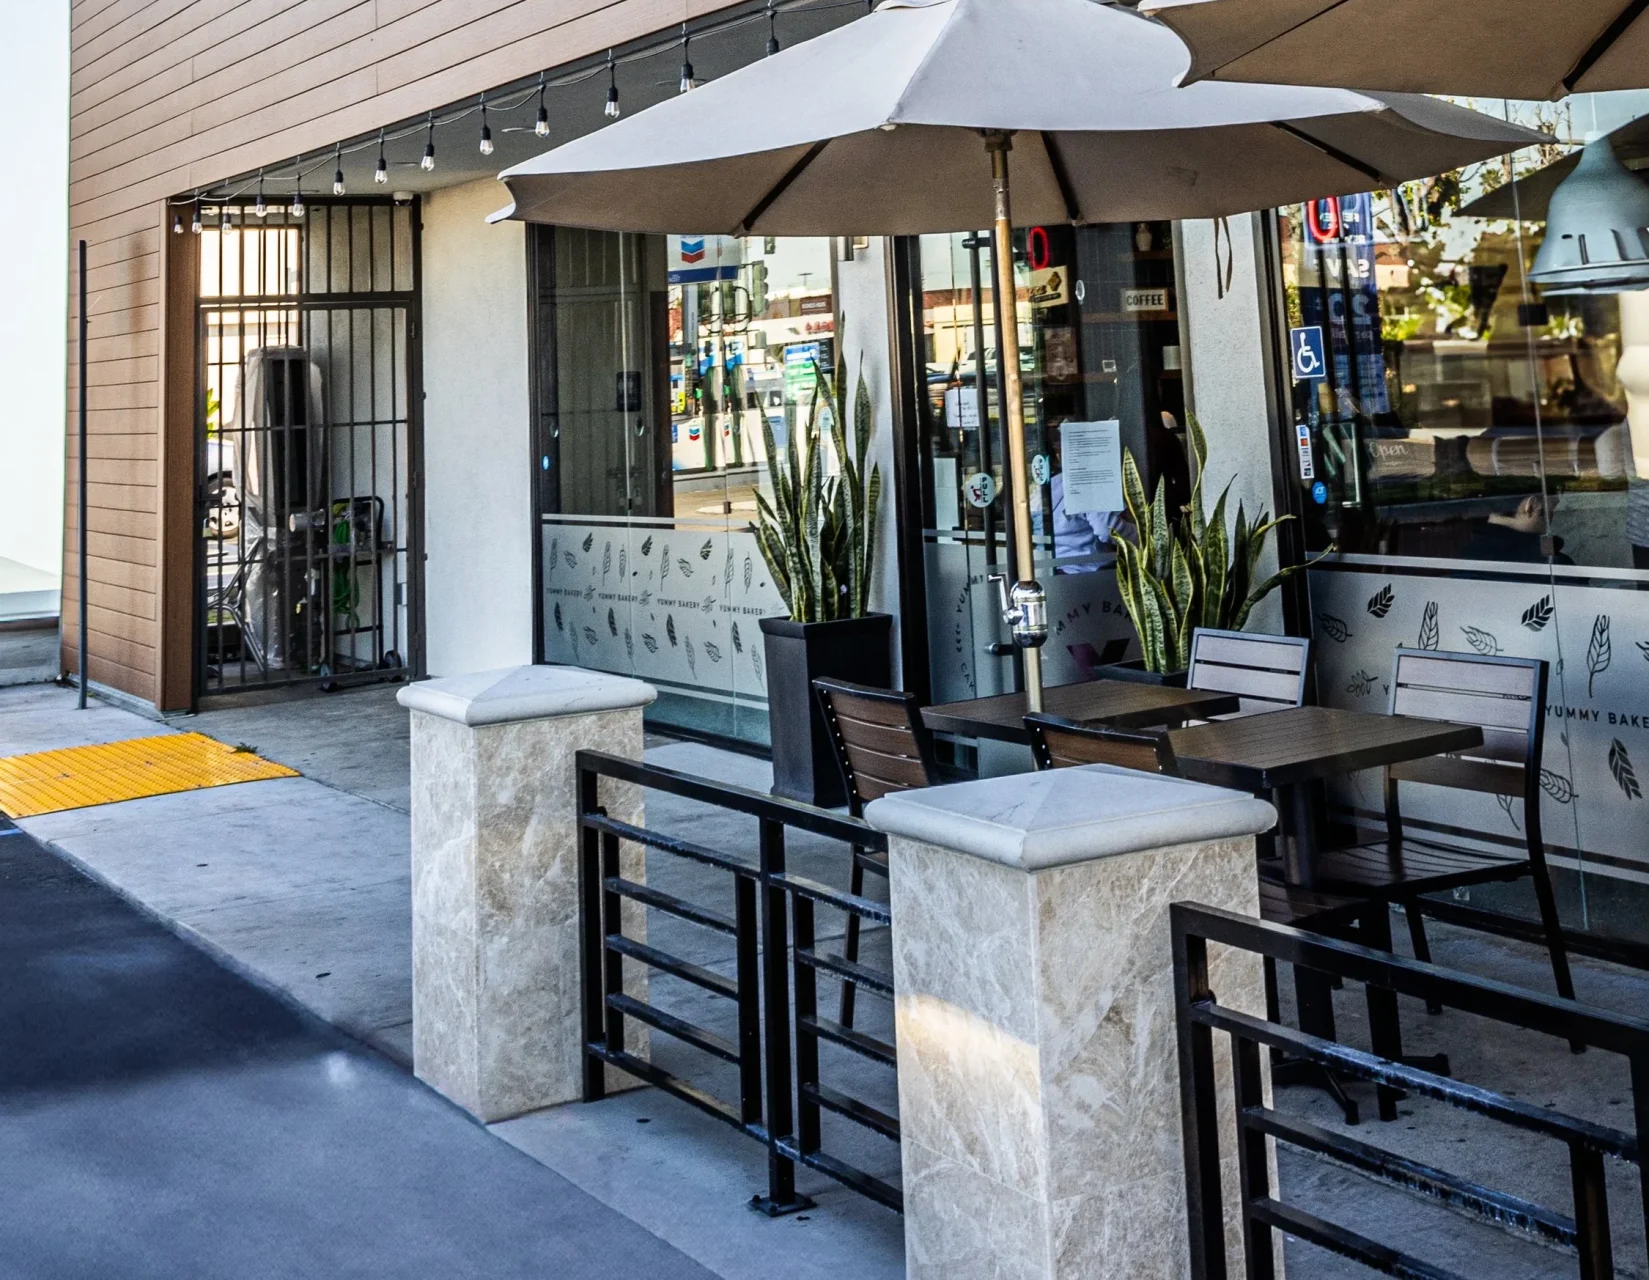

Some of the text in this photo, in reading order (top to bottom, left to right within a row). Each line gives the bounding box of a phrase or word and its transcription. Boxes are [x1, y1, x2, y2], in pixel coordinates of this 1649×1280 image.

[1126, 294, 1164, 306] COFFEE
[1369, 441, 1409, 460] Open
[657, 599, 700, 609] YUMMY BAKERY
[719, 605, 740, 613] YUMMY
[1544, 704, 1599, 722] YUMMY
